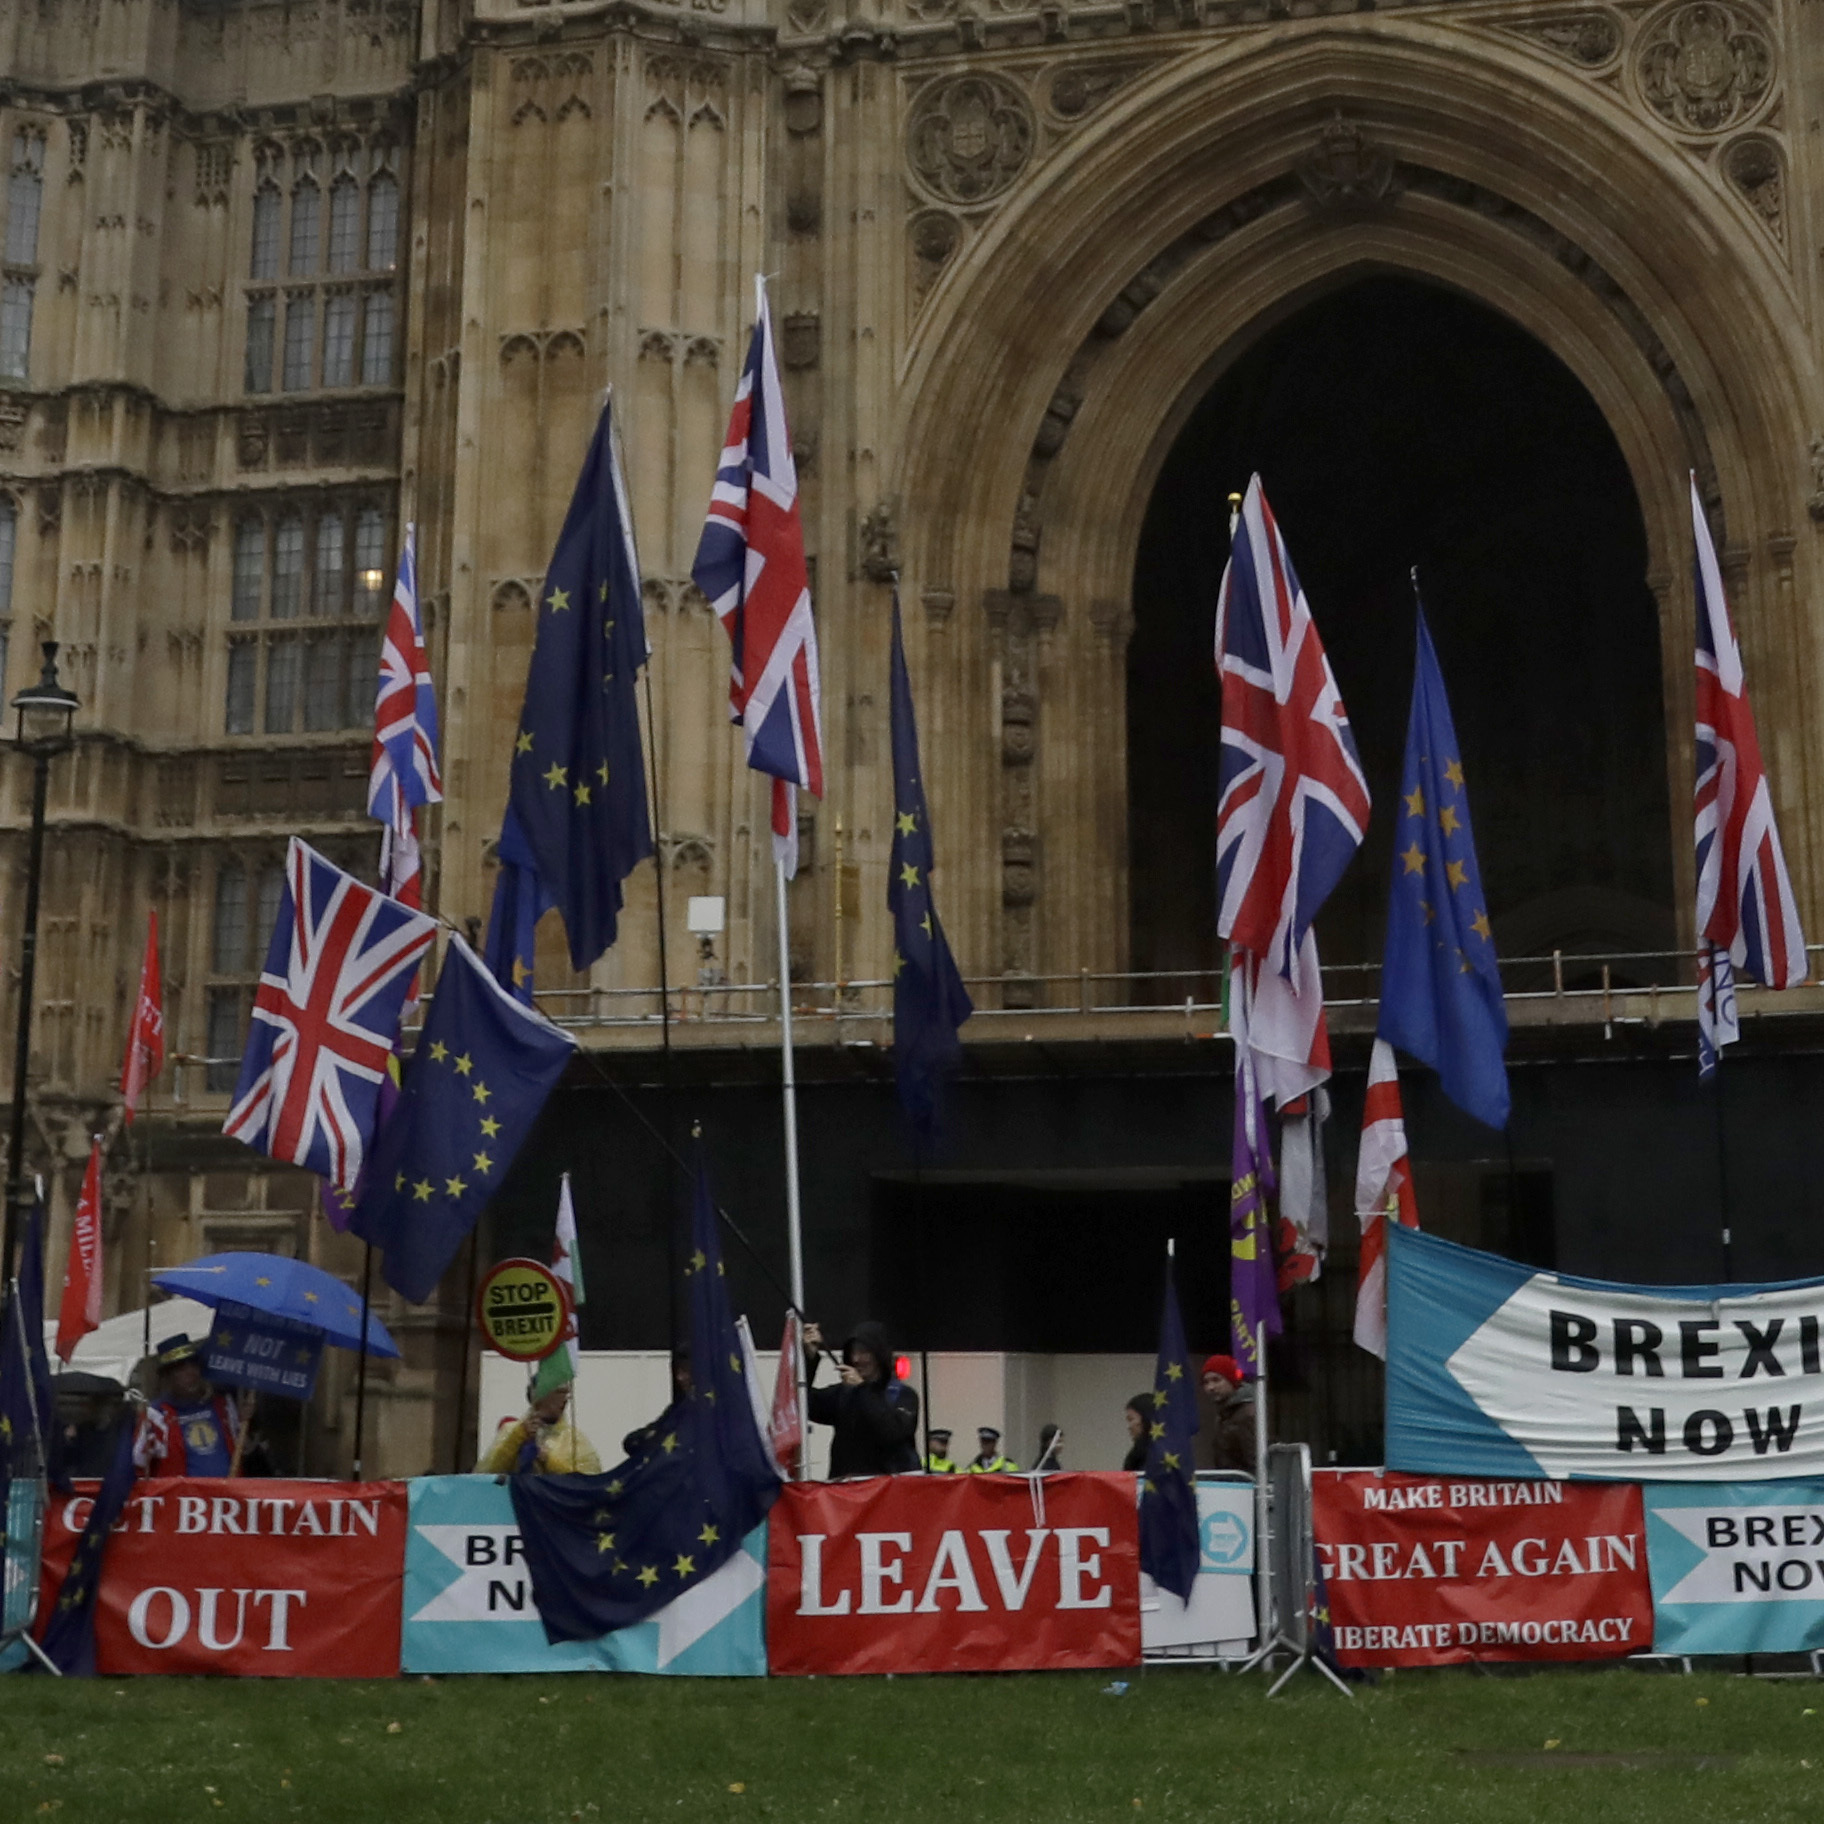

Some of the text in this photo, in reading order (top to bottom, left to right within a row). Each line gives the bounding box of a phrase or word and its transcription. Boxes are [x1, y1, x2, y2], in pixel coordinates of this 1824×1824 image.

[490, 1282, 548, 1304] STOP
[493, 1316, 554, 1336] BREXIT
[243, 1333, 286, 1360] NOT
[1617, 1403, 1803, 1456] NOW
[1363, 1481, 1564, 1510] MAKE BRITAIN
[175, 1496, 381, 1537] BRITAIN
[795, 1527, 1113, 1616] LEAVE
[1476, 1534, 1637, 1578] AGAIN
[127, 1586, 306, 1651] OUT
[1333, 1618, 1633, 1650] IBERATE DEMOCRACY
